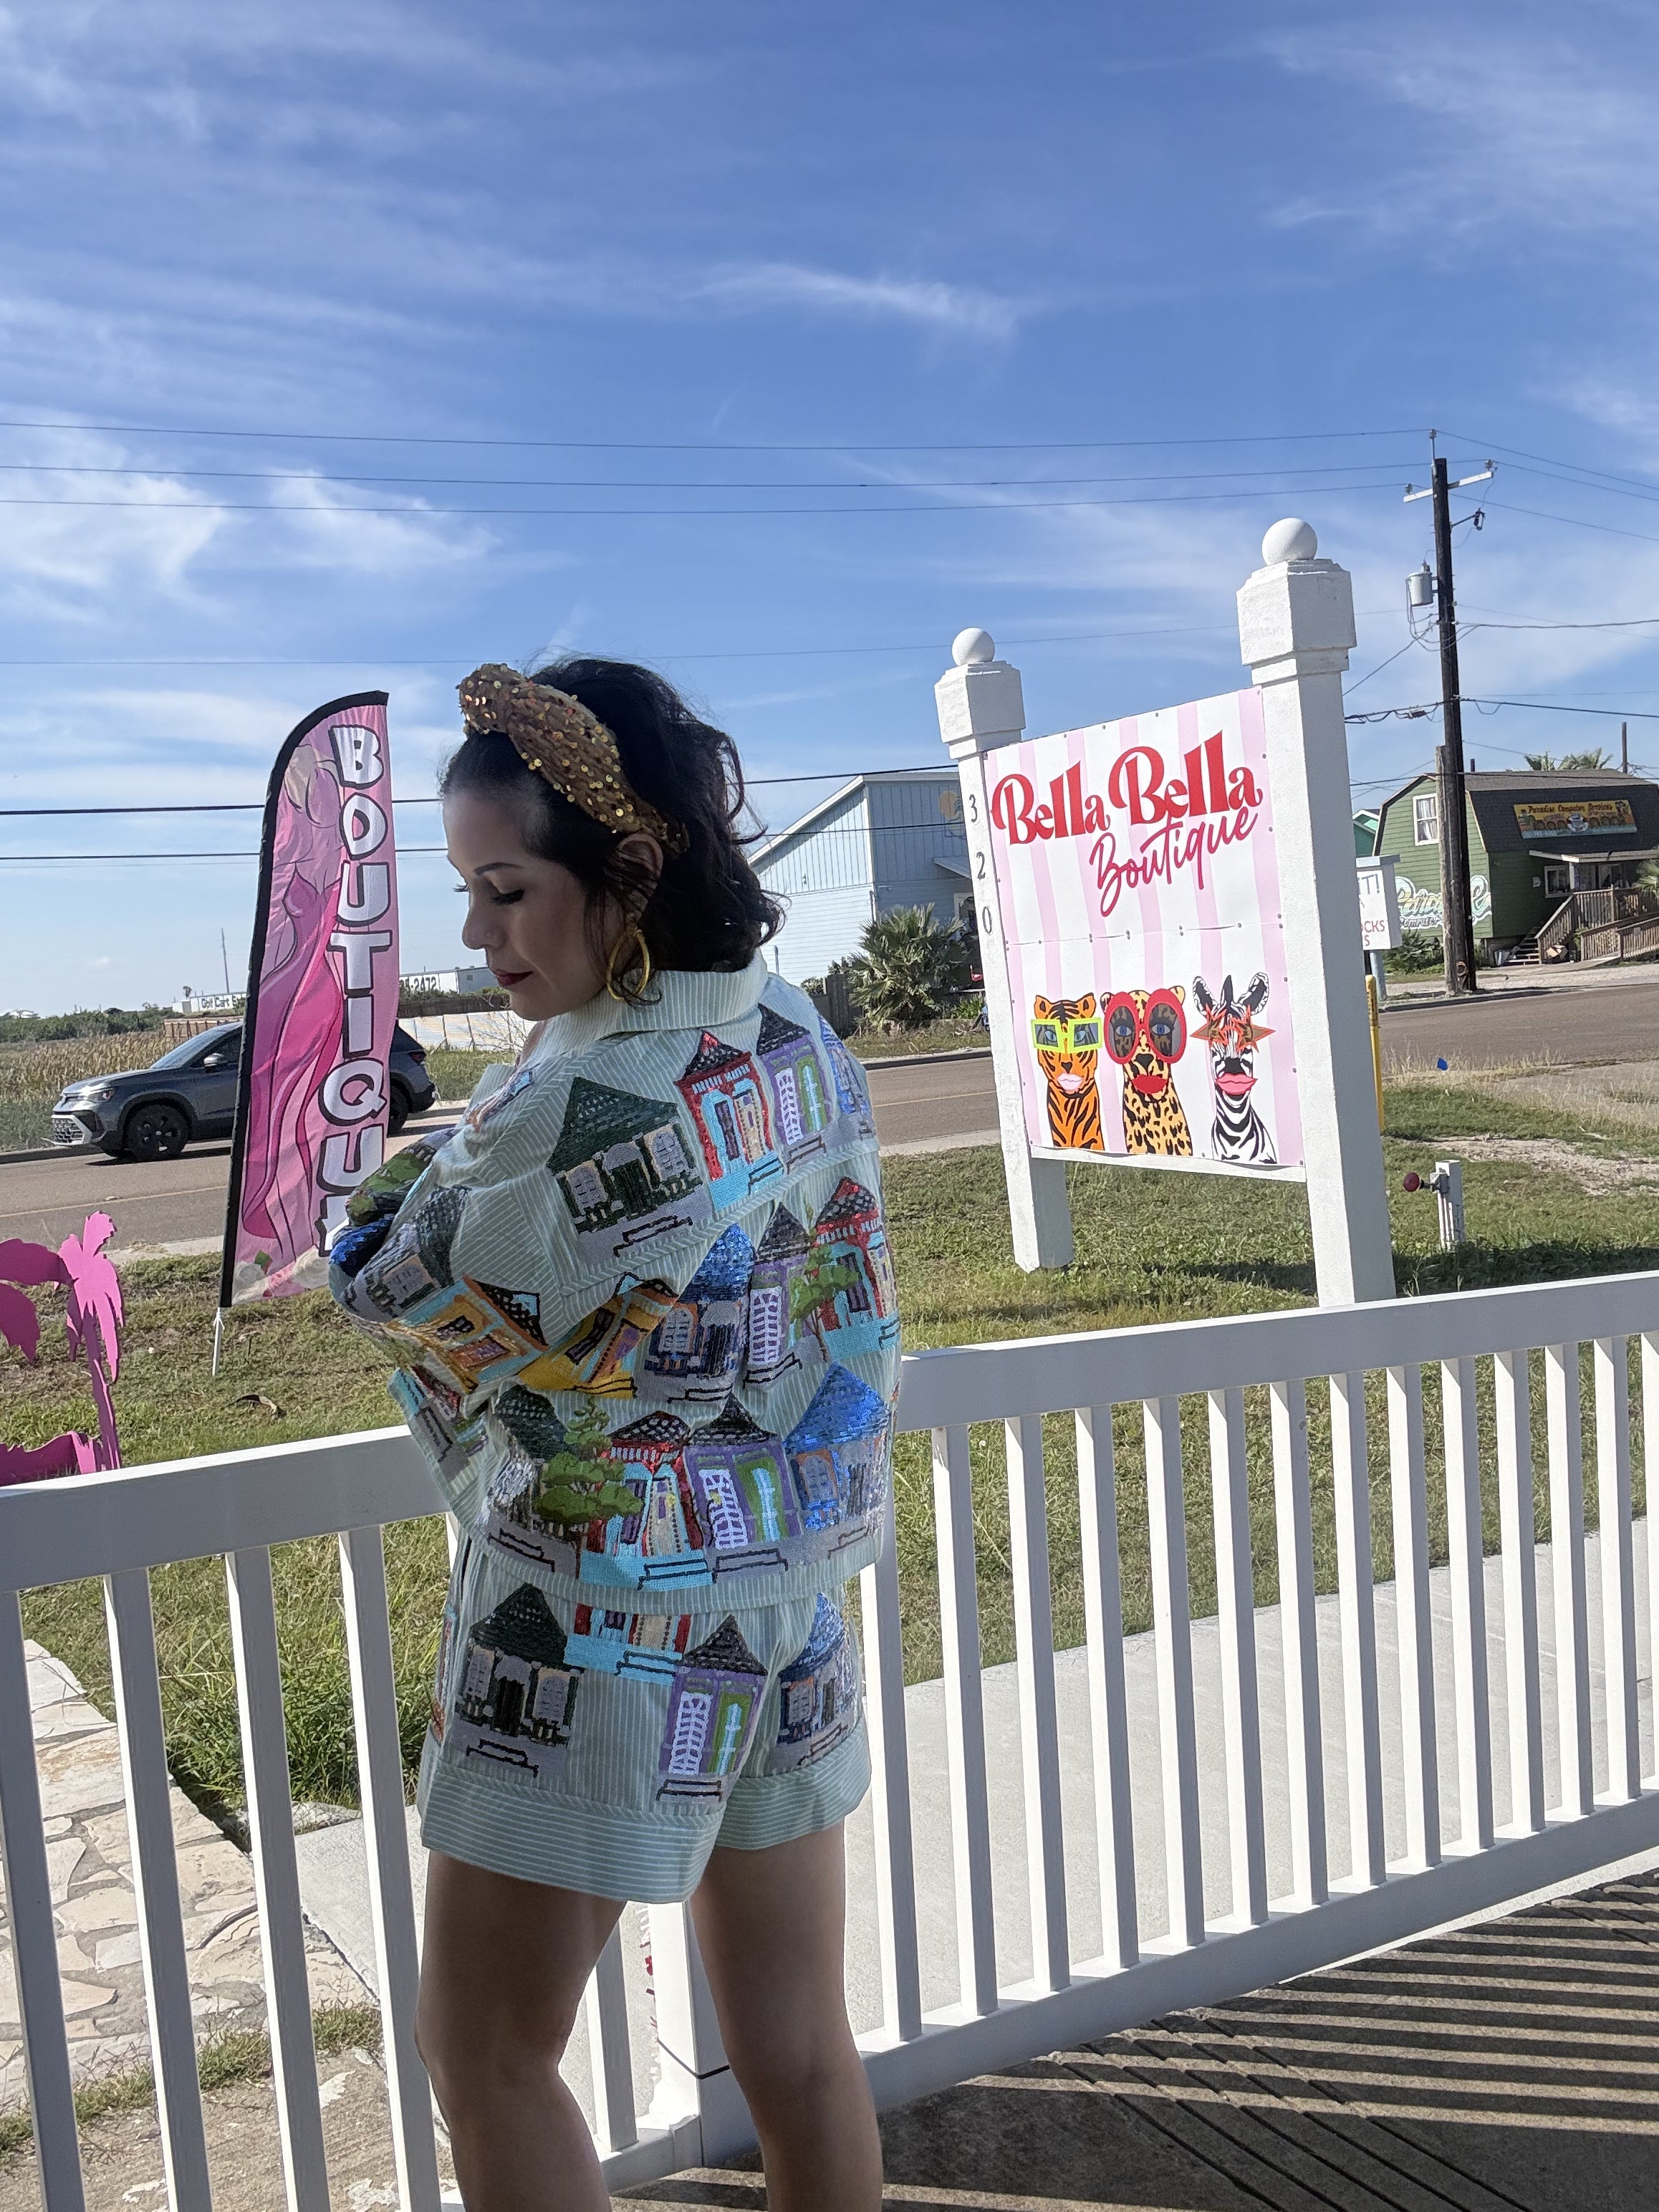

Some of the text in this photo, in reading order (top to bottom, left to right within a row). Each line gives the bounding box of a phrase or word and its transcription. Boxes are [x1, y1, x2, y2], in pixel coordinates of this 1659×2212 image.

[991, 729, 1263, 845] Bella Bella
[1090, 806, 1258, 917] Boutique
[215, 996, 230, 1007] Cart
